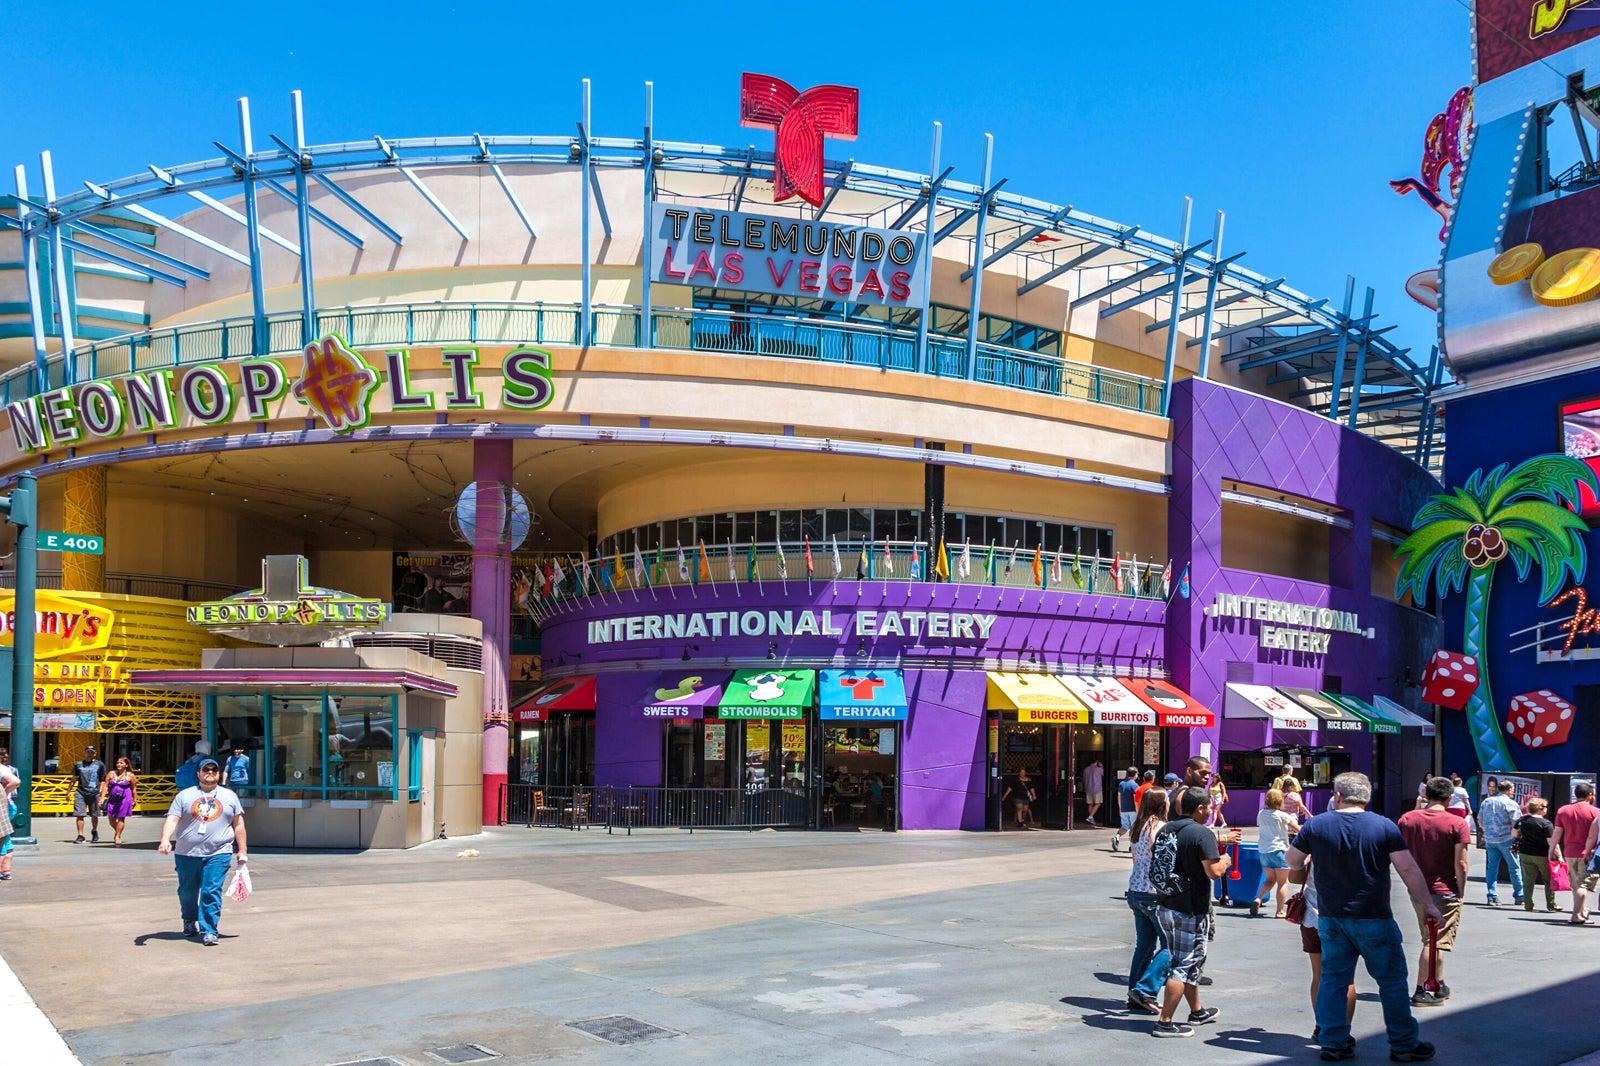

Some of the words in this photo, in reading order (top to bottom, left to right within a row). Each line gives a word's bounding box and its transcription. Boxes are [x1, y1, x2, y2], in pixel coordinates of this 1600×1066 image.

[666, 209, 915, 265] TELEMUNDO
[664, 245, 745, 284] LAS
[767, 256, 911, 301] VEGAS
[47, 535, 58, 547] E
[63, 537, 98, 550] 400
[396, 556, 414, 567] Get
[415, 556, 437, 568] your
[1216, 593, 1362, 635] INTERNATIONAL
[0, 609, 102, 640] eny's
[587, 610, 843, 644] INTERNATIONAL
[856, 610, 998, 639] EATERY
[1260, 625, 1332, 655] EATERY
[61, 664, 113, 678] DINER
[52, 687, 98, 703] OPEN
[520, 710, 540, 720] RAMEN
[643, 706, 689, 716] SWEETS
[721, 706, 799, 717] STROMBOLIS
[833, 706, 896, 717] TERIYAKI
[1030, 710, 1078, 721] BURGERS
[1101, 712, 1149, 722] BURRITOS
[1166, 715, 1207, 725] NOODLES
[1284, 719, 1307, 728] TACOS
[1327, 720, 1341, 730] RICE
[1342, 720, 1362, 731] BOWLS
[1374, 723, 1398, 734] PIZZERIA
[783, 734, 804, 742] 10%
